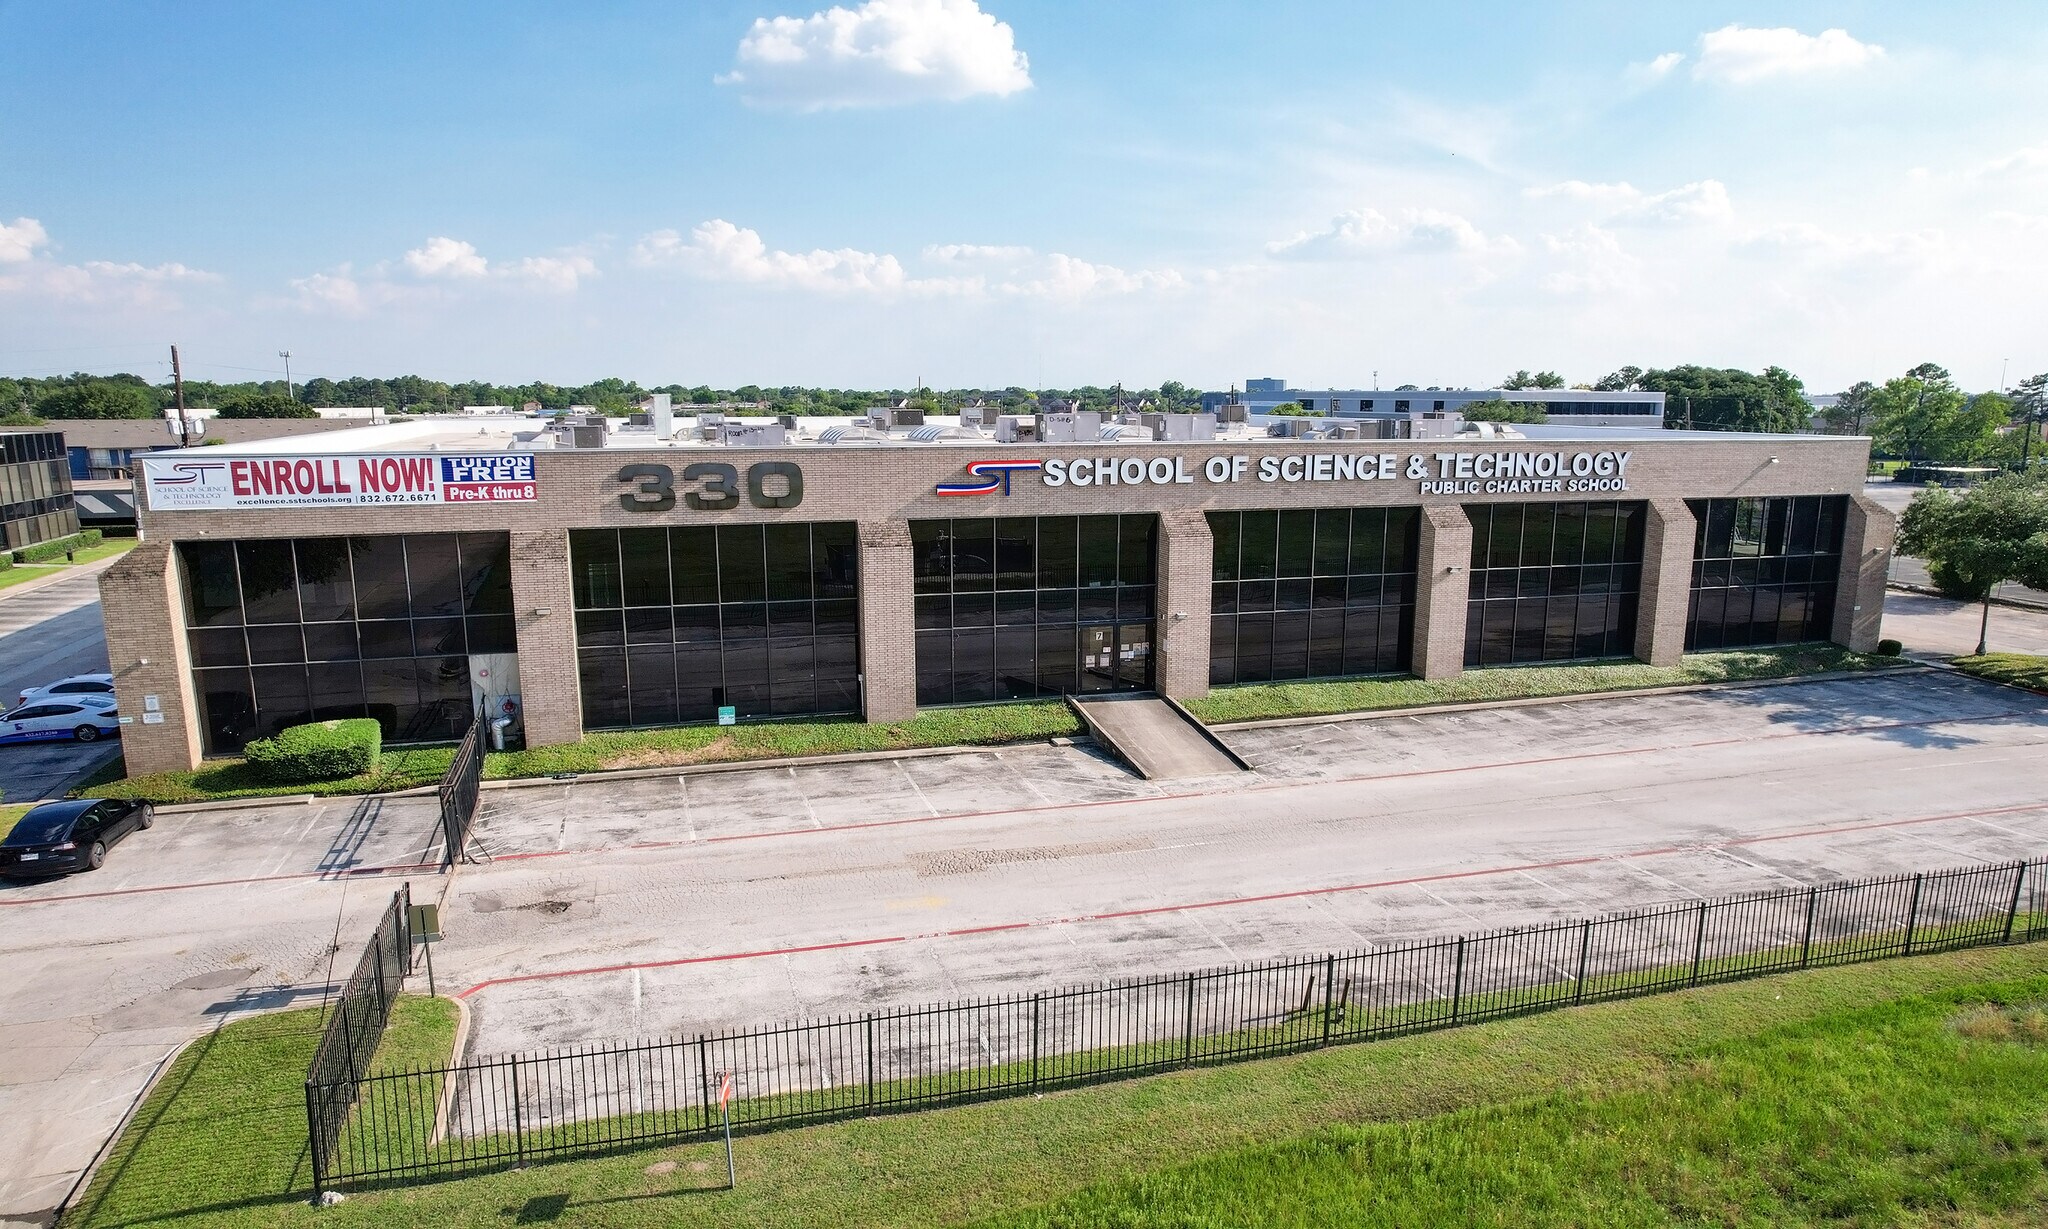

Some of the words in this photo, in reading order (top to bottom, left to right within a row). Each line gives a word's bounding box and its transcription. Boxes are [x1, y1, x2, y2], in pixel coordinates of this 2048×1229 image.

[447, 456, 531, 469] TUITION
[1042, 456, 1194, 488] SCHOOL
[1204, 454, 1250, 484] OF
[1257, 453, 1398, 483] SCIENCE
[1405, 454, 1430, 480] &
[1434, 450, 1633, 479] TECHNOLOGY
[229, 459, 352, 496] ENROLL
[358, 457, 436, 494] NOW!
[452, 466, 533, 482] FREE
[154, 486, 186, 494] SCHOOL
[449, 486, 489, 501] Pre-K
[492, 486, 523, 500] thru
[523, 485, 536, 499] 8
[618, 461, 804, 512] 330
[1419, 480, 1481, 496] PUBLIC
[1485, 478, 1562, 494] CHARTER
[1567, 477, 1631, 493] SCHOOL
[236, 496, 352, 506] excellence.sstschools.org
[360, 493, 437, 503] 832.672.6671
